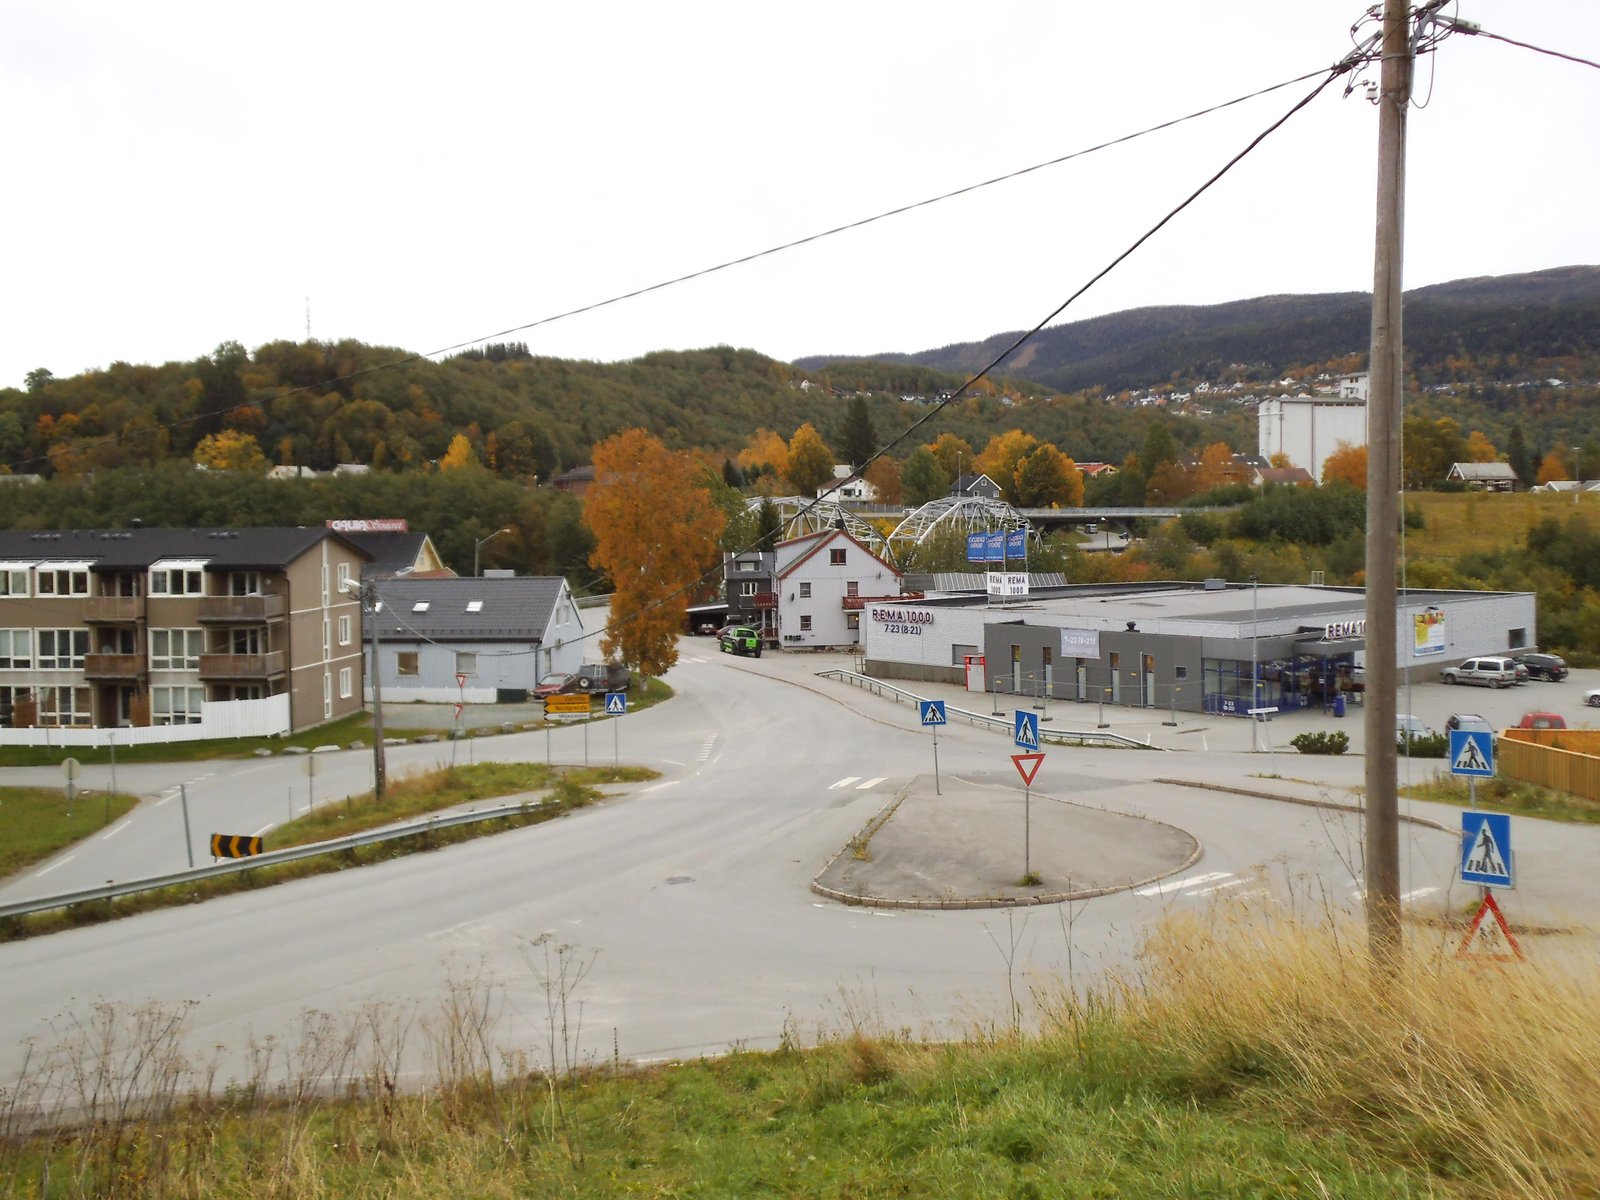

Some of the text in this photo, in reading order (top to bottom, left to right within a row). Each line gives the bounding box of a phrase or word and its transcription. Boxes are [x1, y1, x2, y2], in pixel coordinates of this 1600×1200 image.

[989, 575, 1003, 584] REMA
[1007, 576, 1026, 585] REMA
[1010, 586, 1024, 594] 1000
[872, 608, 933, 623] REMA 1000
[884, 623, 922, 636] 7-23 (8-21)
[1326, 622, 1357, 639] REMA
